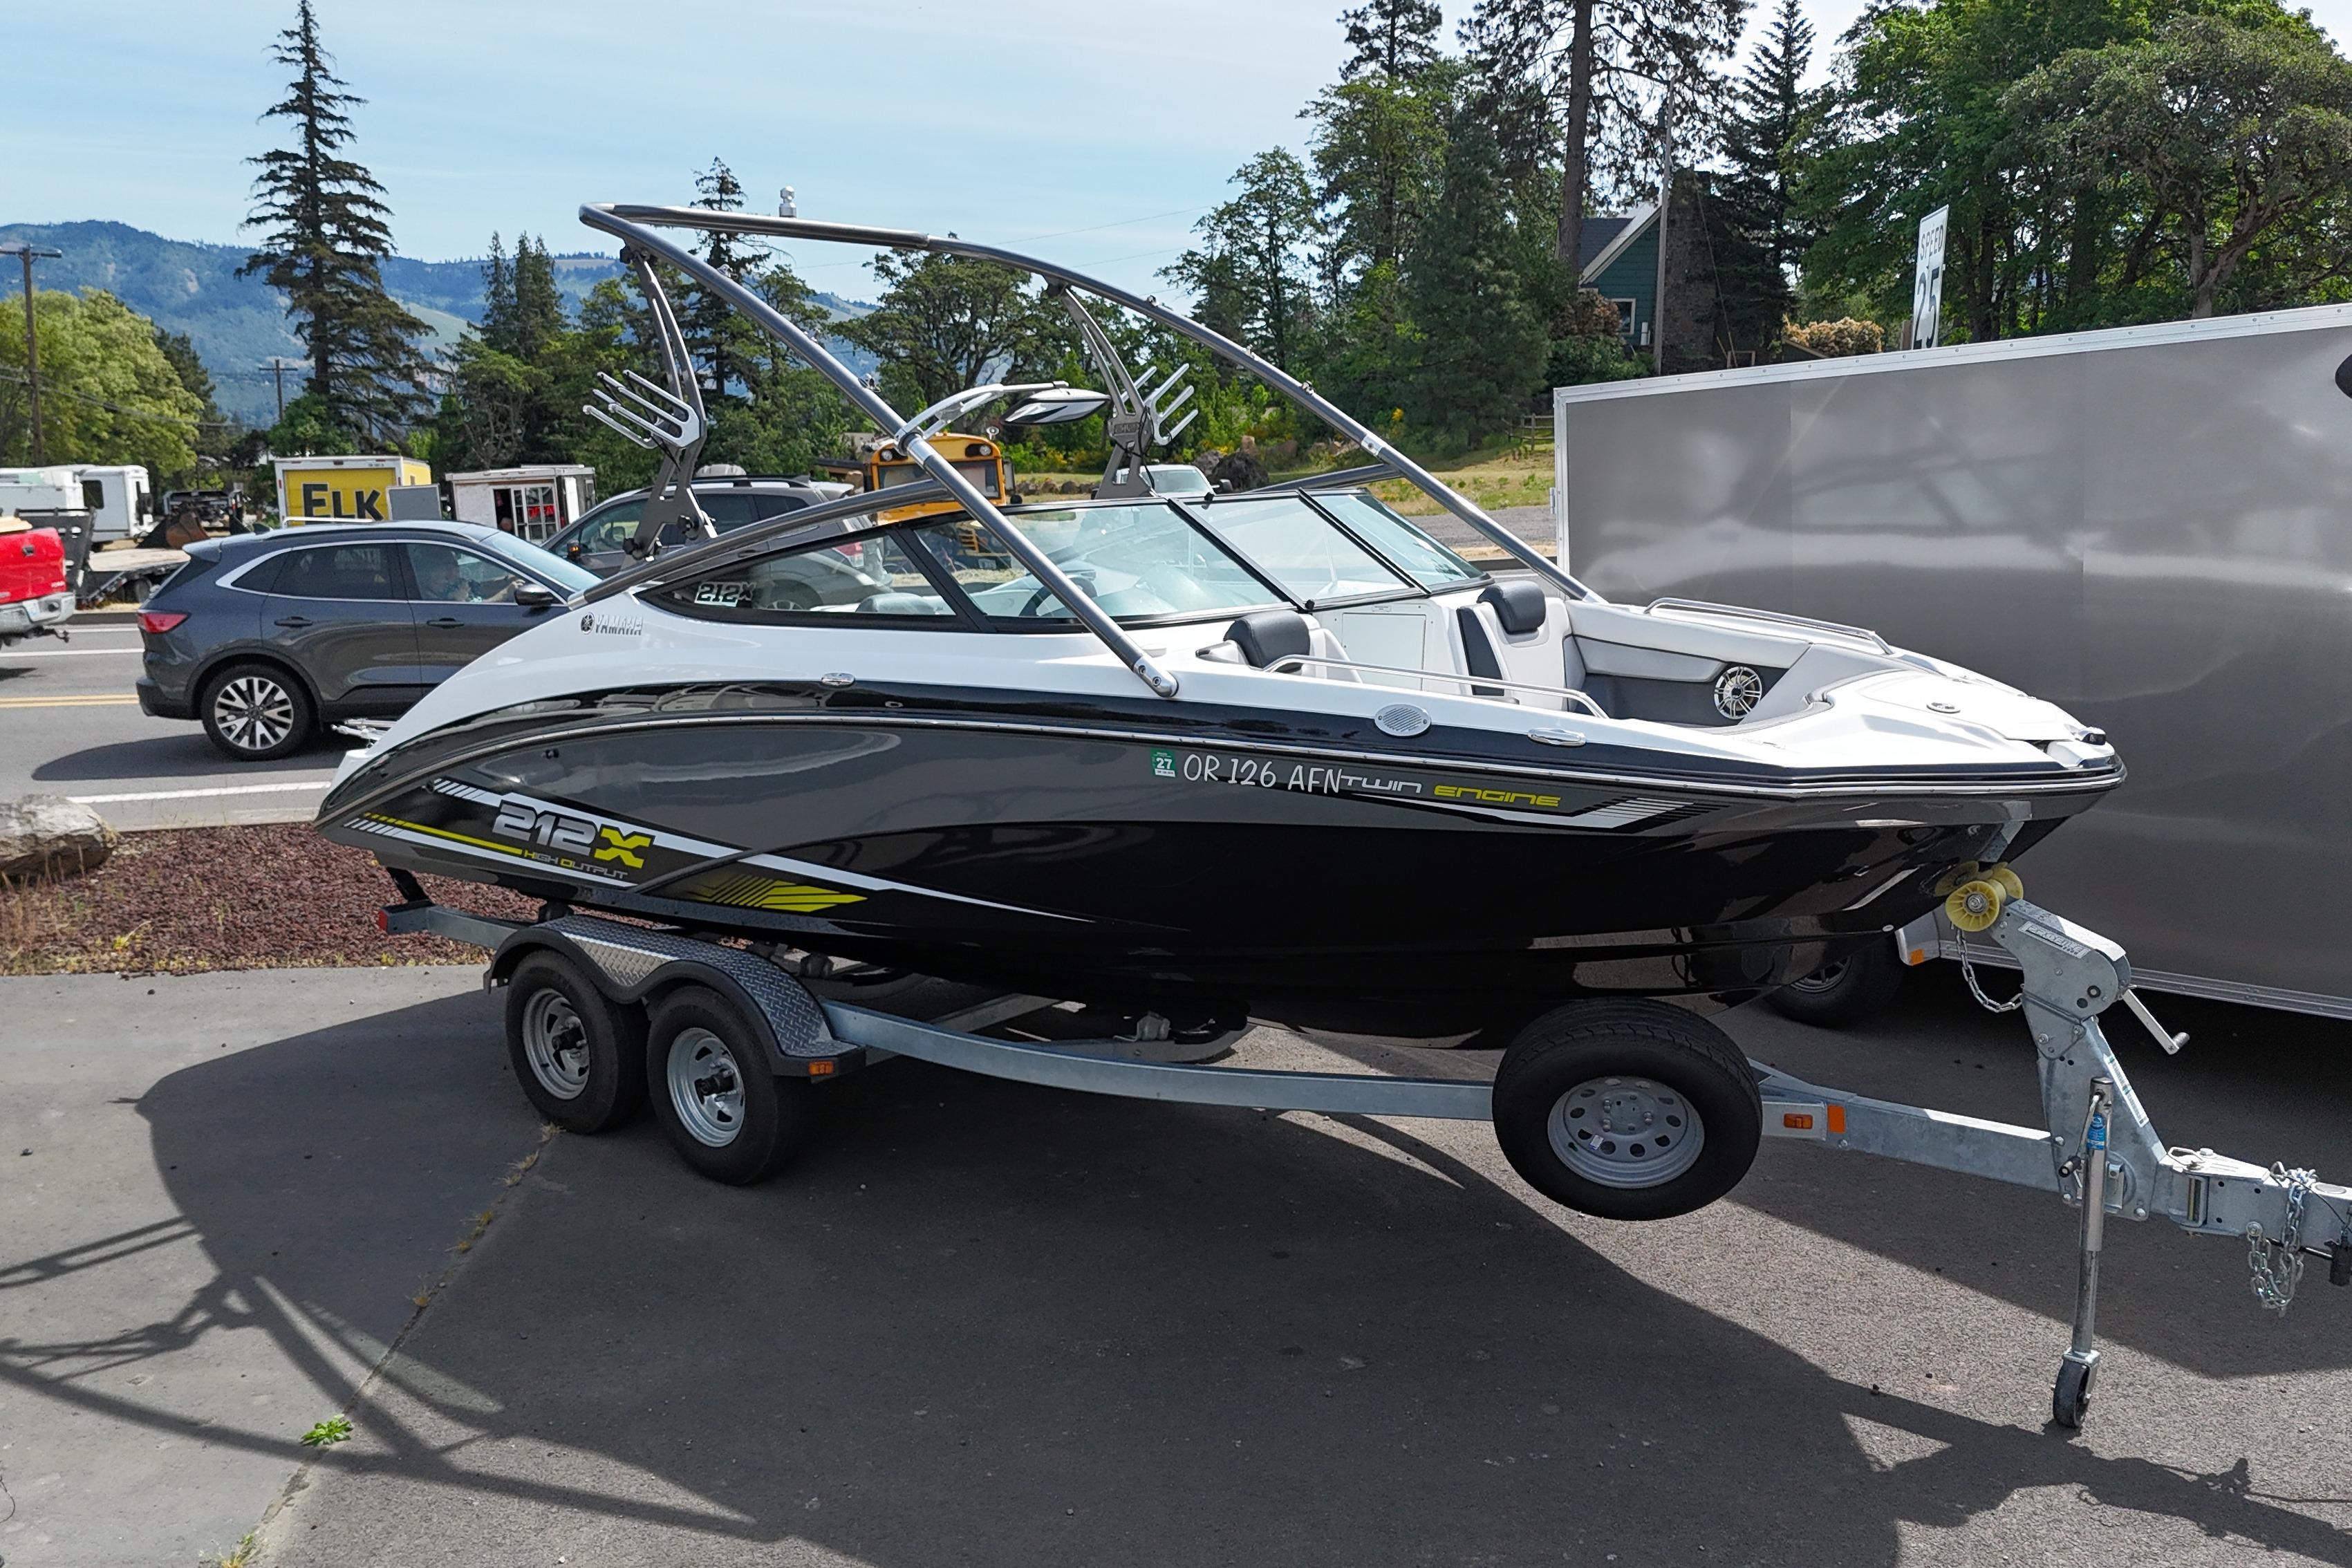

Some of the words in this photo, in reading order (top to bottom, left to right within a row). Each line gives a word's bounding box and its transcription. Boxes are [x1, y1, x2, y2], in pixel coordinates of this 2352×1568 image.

[1921, 225, 1943, 260] SPEED
[1914, 266, 1940, 350] 25
[302, 483, 384, 524] ELK
[696, 582, 756, 605] 212X
[595, 614, 644, 636] YAMAHA
[1156, 757, 1173, 769] 27
[1184, 754, 1220, 782] OR
[1227, 758, 1276, 788] 126
[1287, 764, 1343, 794] AFN
[492, 802, 653, 869] 212X
[524, 848, 559, 863] HIGH
[560, 858, 628, 880] OUTPUT
